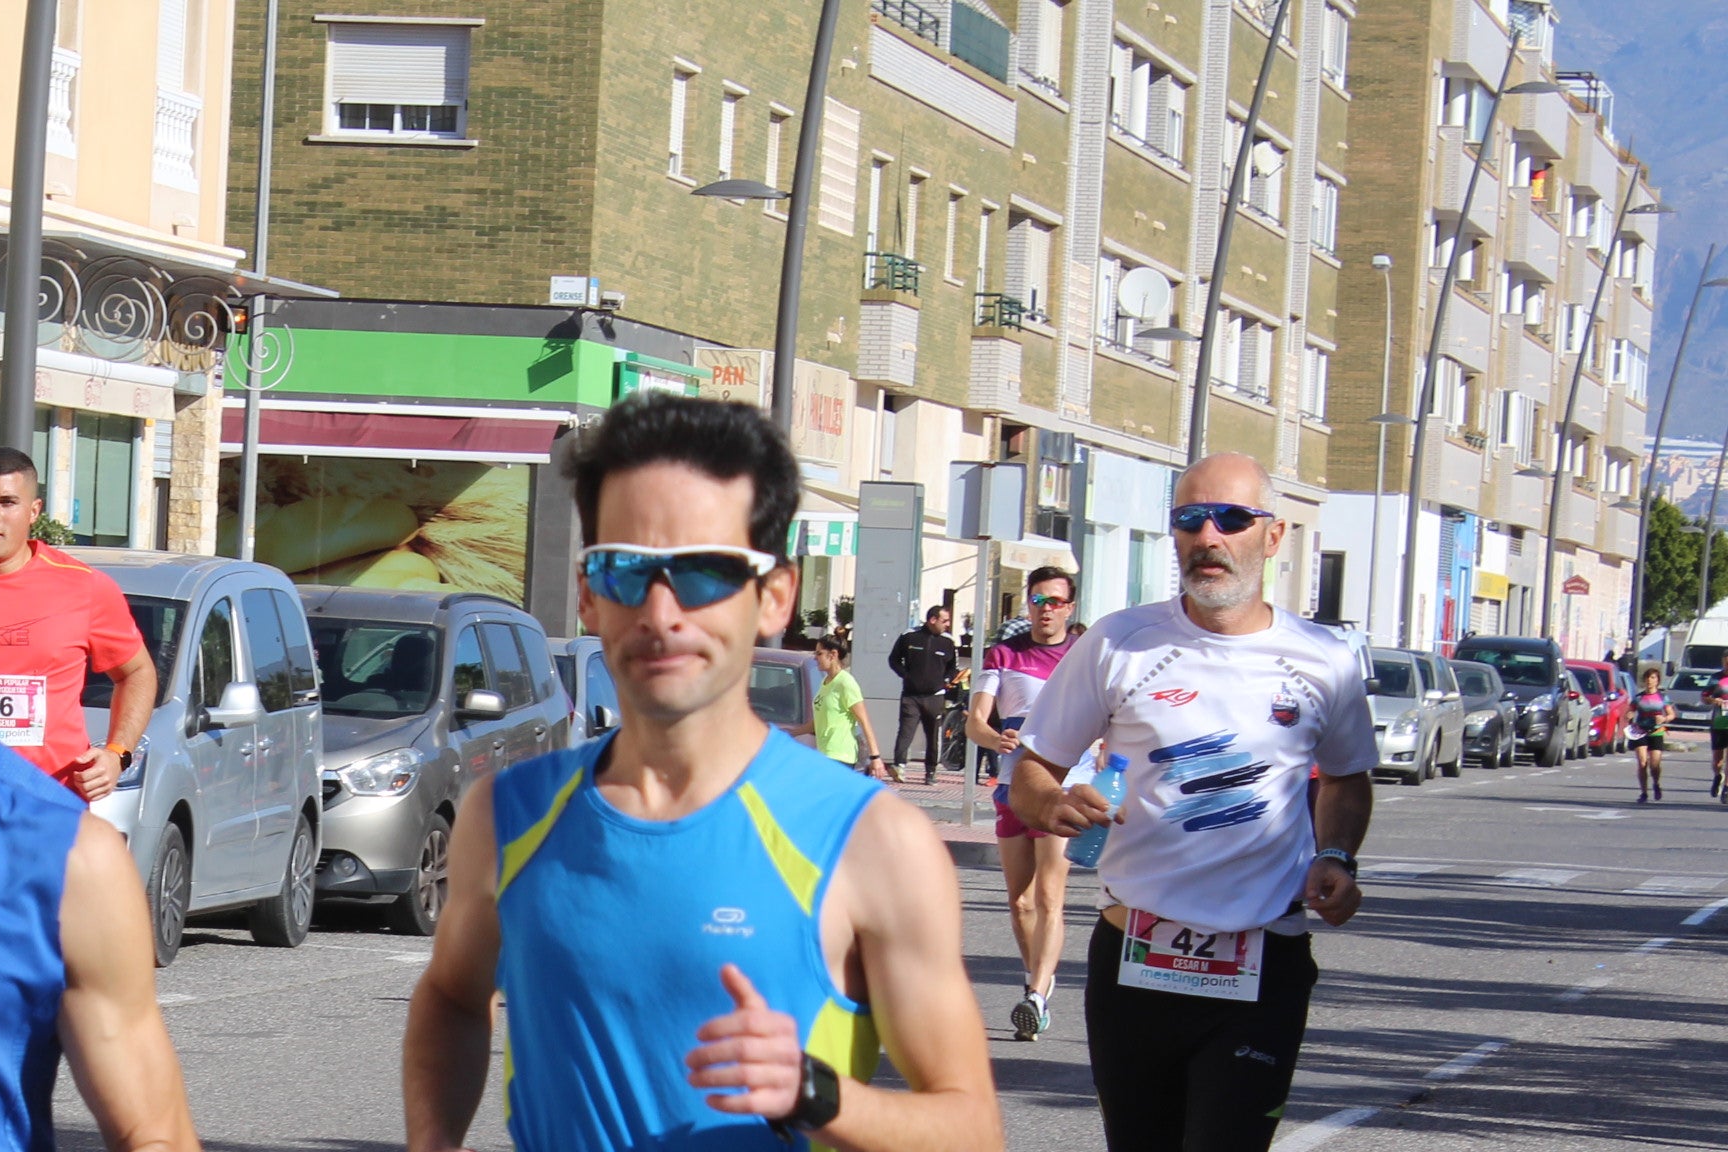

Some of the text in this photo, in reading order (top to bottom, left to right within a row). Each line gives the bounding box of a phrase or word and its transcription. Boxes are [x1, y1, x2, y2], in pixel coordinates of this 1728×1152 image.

[553, 291, 584, 301] ORENSE
[712, 365, 745, 386] PAN
[1170, 927, 1217, 958] 42
[1173, 957, 1210, 972] CESAR M
[1140, 967, 1240, 988] meetingpoint
